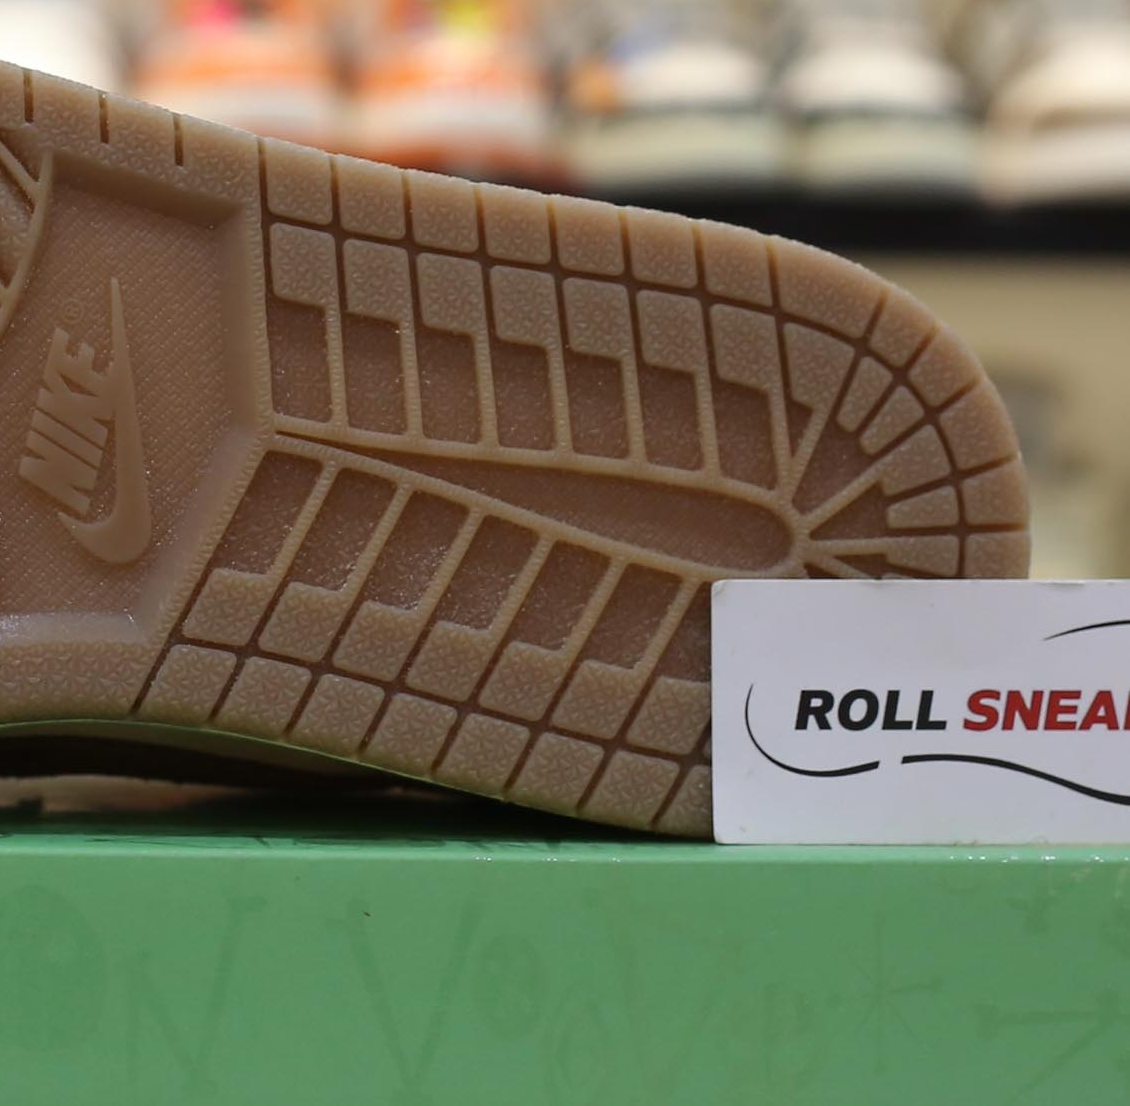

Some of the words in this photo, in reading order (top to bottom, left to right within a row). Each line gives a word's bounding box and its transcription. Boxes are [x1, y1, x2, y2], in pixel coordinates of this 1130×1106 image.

[18, 326, 114, 516] NIKE
[794, 689, 948, 732] ROLL
[962, 689, 1130, 732] SNEA
